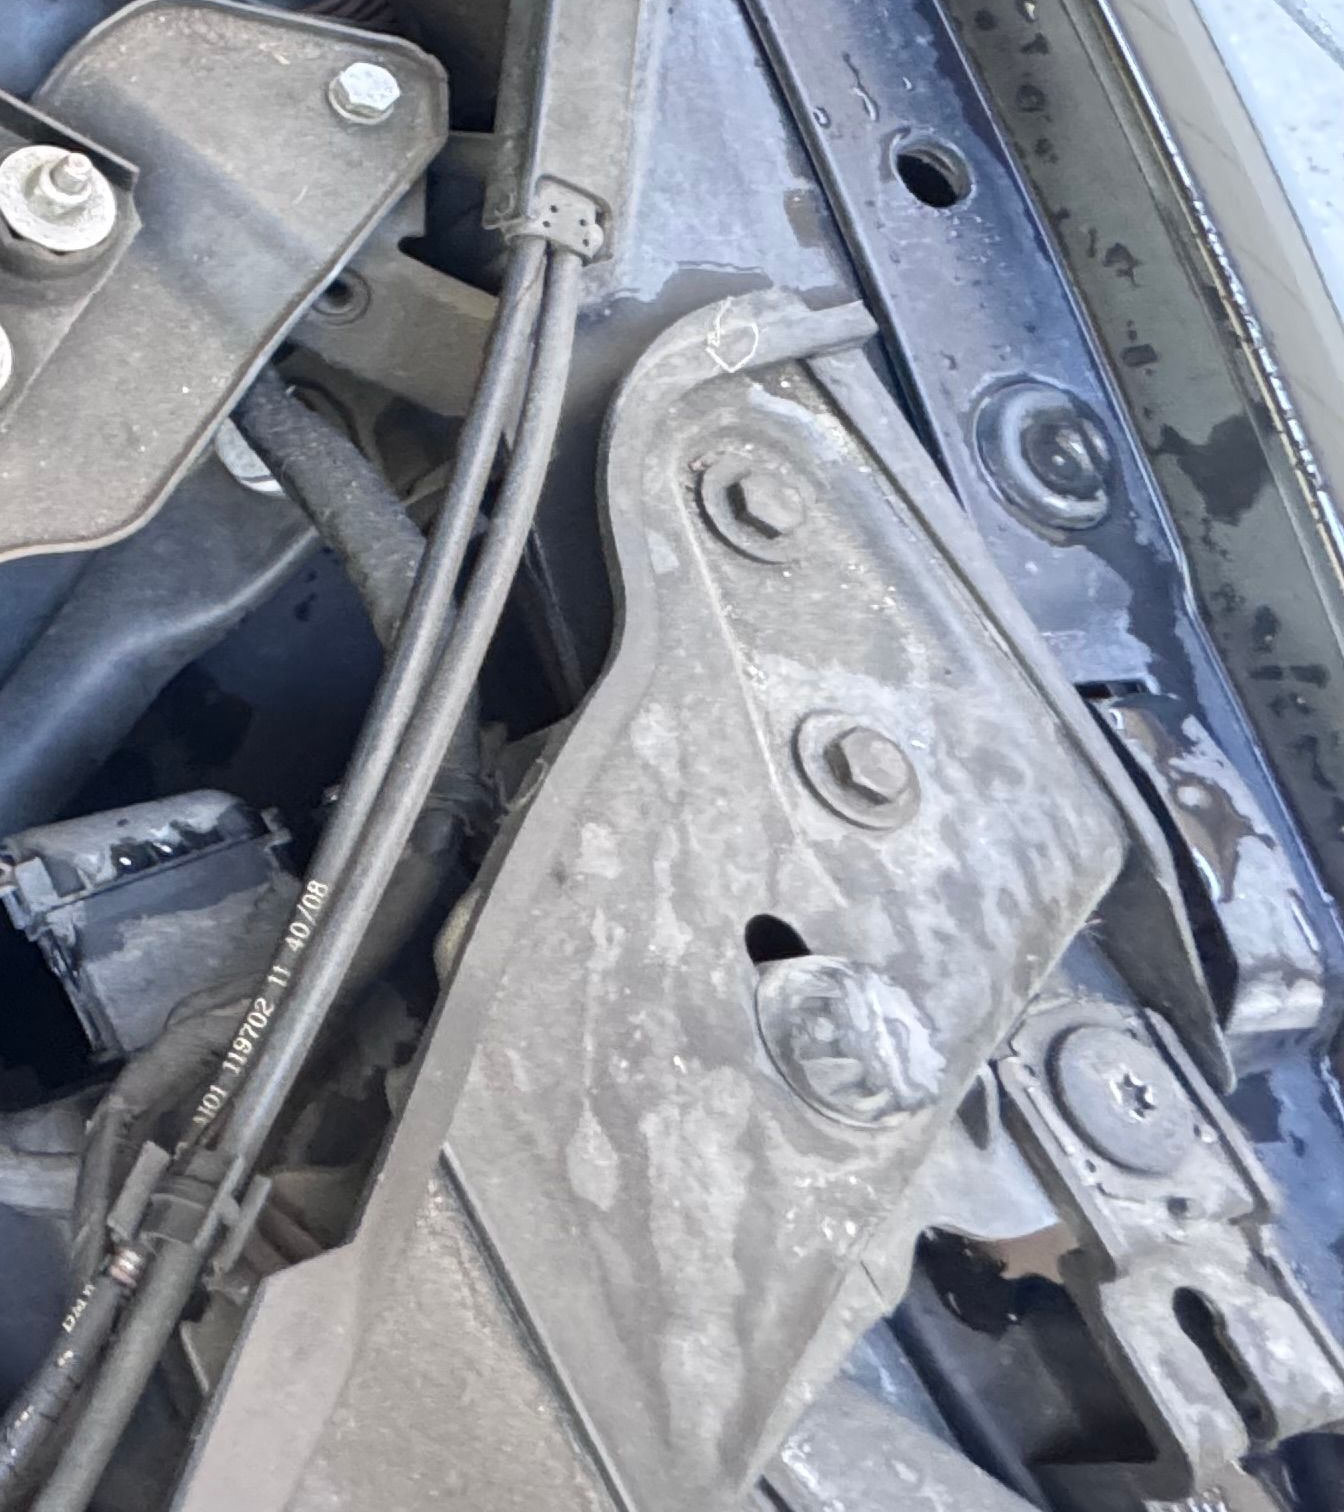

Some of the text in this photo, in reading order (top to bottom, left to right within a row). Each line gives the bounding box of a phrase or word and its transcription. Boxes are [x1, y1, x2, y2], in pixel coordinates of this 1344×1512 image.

[222, 996, 276, 1076] 119702
[267, 964, 292, 988] 11
[284, 879, 330, 953] 40/08
